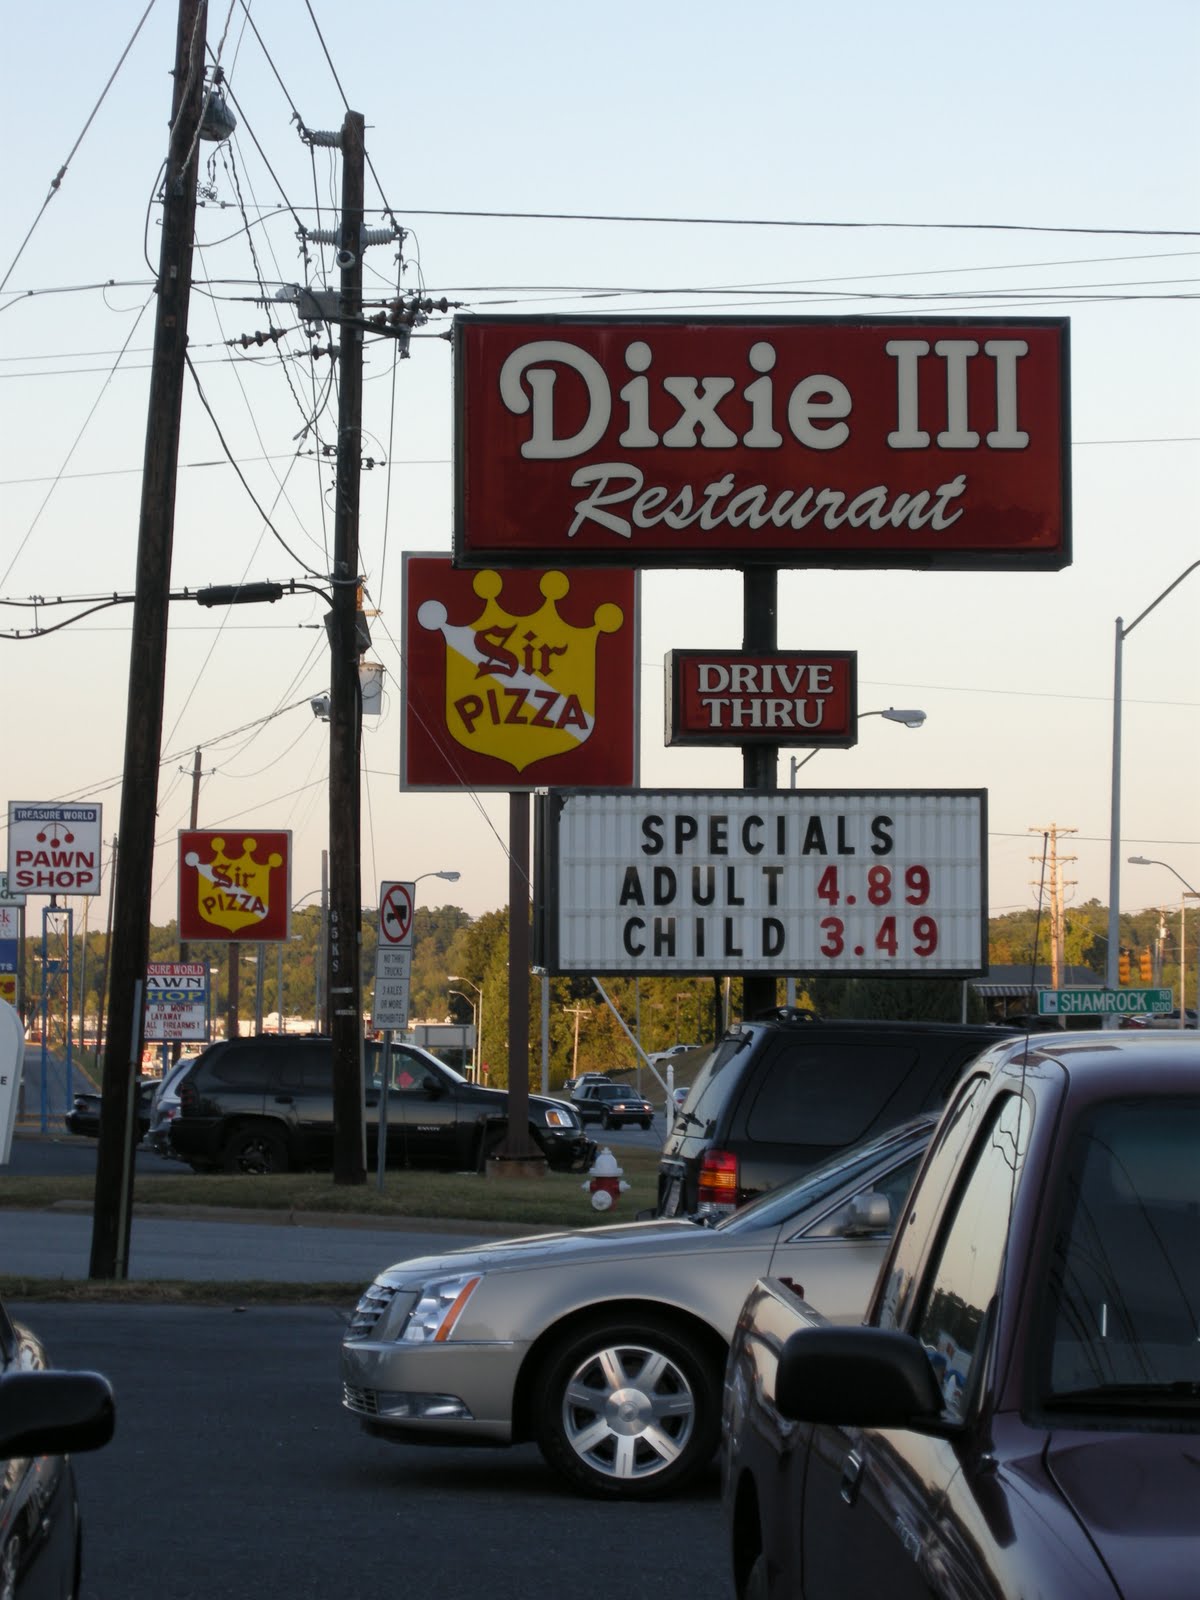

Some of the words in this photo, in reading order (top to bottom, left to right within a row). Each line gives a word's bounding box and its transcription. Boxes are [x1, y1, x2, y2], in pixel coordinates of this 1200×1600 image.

[499, 340, 853, 459] Dixie
[885, 340, 1030, 449] III
[567, 462, 967, 539] Restaurant
[473, 623, 568, 680] Sir
[697, 664, 834, 694] DRIVE
[453, 688, 589, 734] PIZZA
[702, 698, 825, 728] THRU
[17, 810, 61, 820] TREASURE
[63, 811, 94, 821] WORLD
[641, 815, 894, 855] SPECIALS
[15, 850, 94, 869] PAWN
[16, 870, 93, 887] SHOP
[211, 864, 256, 889] Sir
[619, 866, 784, 906] ADULT
[817, 865, 930, 906] 4.89
[202, 893, 266, 915] PIZZA
[623, 917, 785, 957] CHILD
[820, 916, 938, 957] 3.49
[173, 965, 204, 975] WORLD
[171, 1004, 193, 1012] MONTH
[1060, 992, 1148, 1012] SHAMROCK
[1159, 990, 1171, 1000] RD
[1151, 1002, 1171, 1012] 1200
[146, 1021, 157, 1029] ALL
